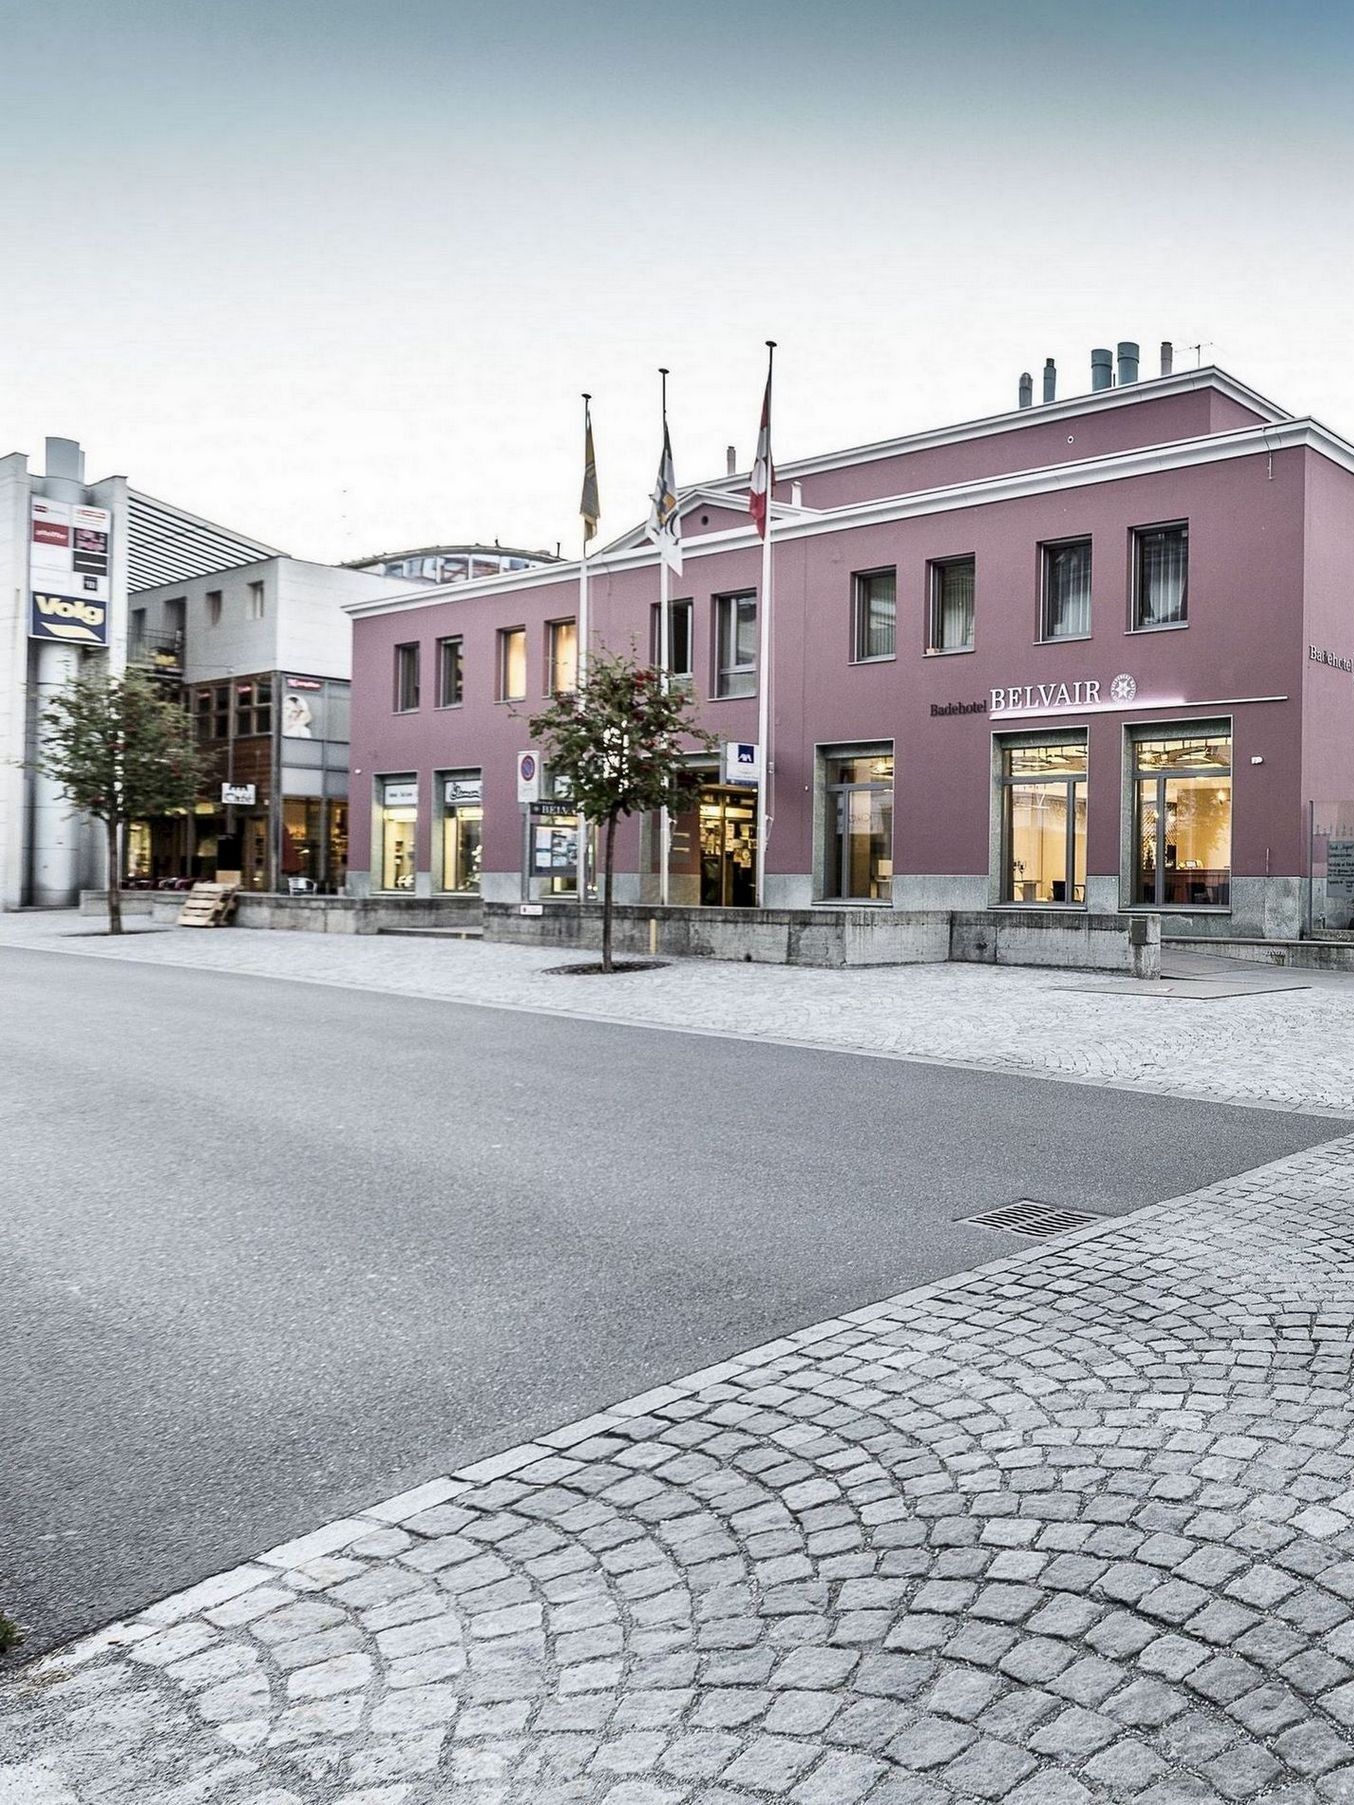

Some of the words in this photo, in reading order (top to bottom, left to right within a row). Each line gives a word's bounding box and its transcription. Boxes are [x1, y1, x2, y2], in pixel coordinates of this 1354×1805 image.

[35, 595, 105, 625] Volg
[930, 700, 987, 717] Badehotel
[989, 680, 1101, 712] BELVAIR
